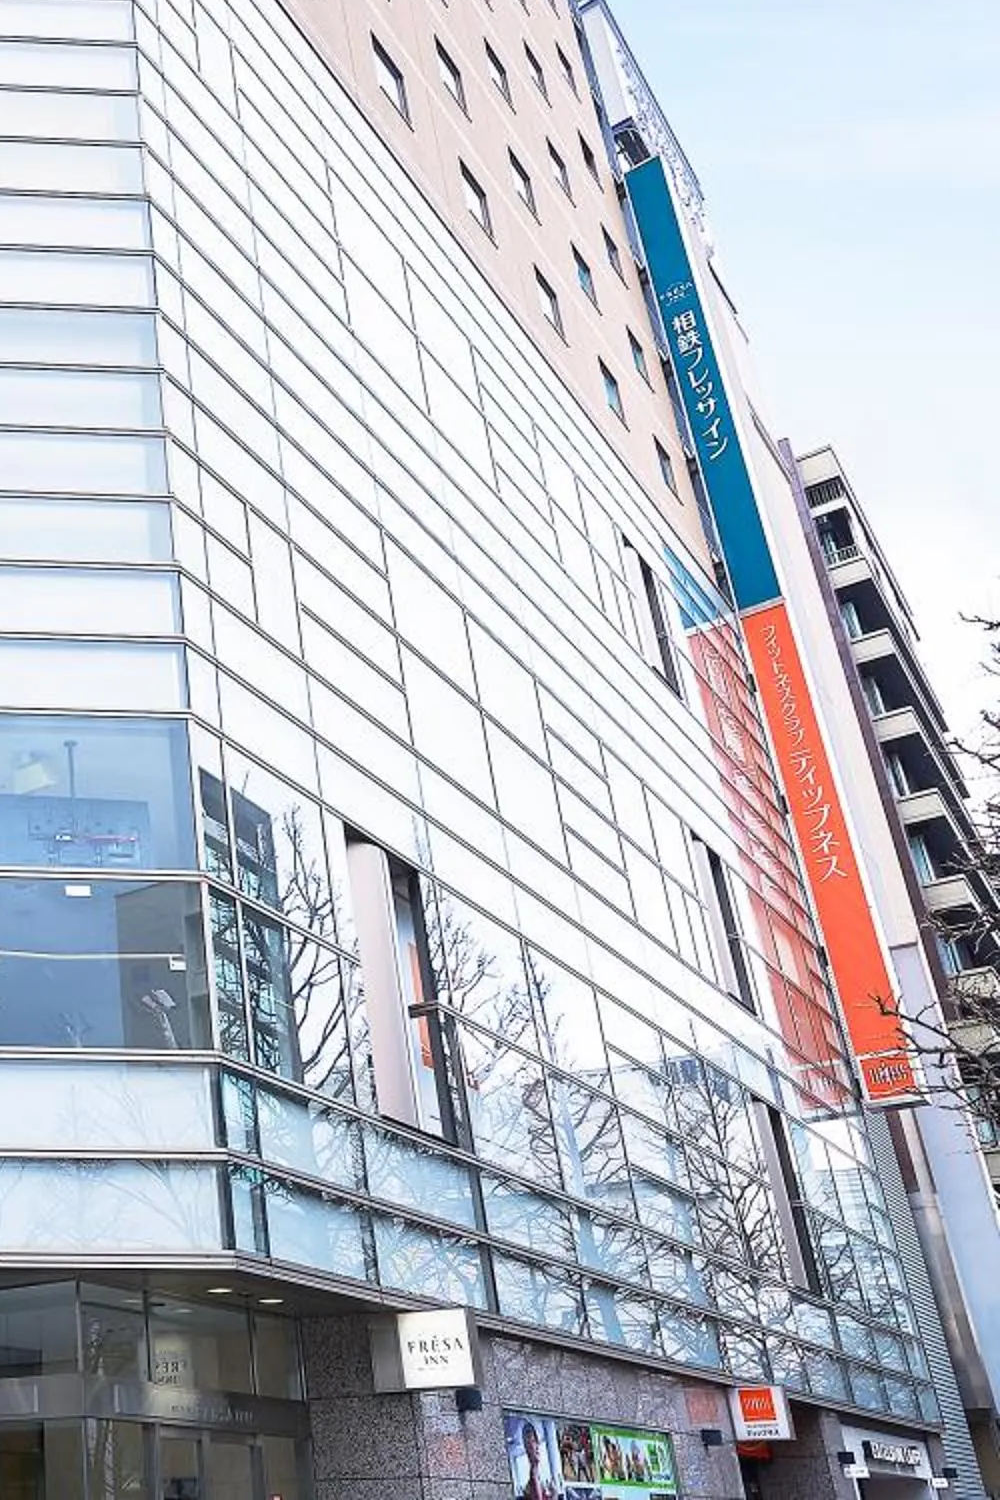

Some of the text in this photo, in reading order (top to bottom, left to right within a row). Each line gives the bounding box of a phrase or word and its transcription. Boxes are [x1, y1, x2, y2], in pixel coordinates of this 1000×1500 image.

[672, 310, 728, 460] 相鉄フレッサイン
